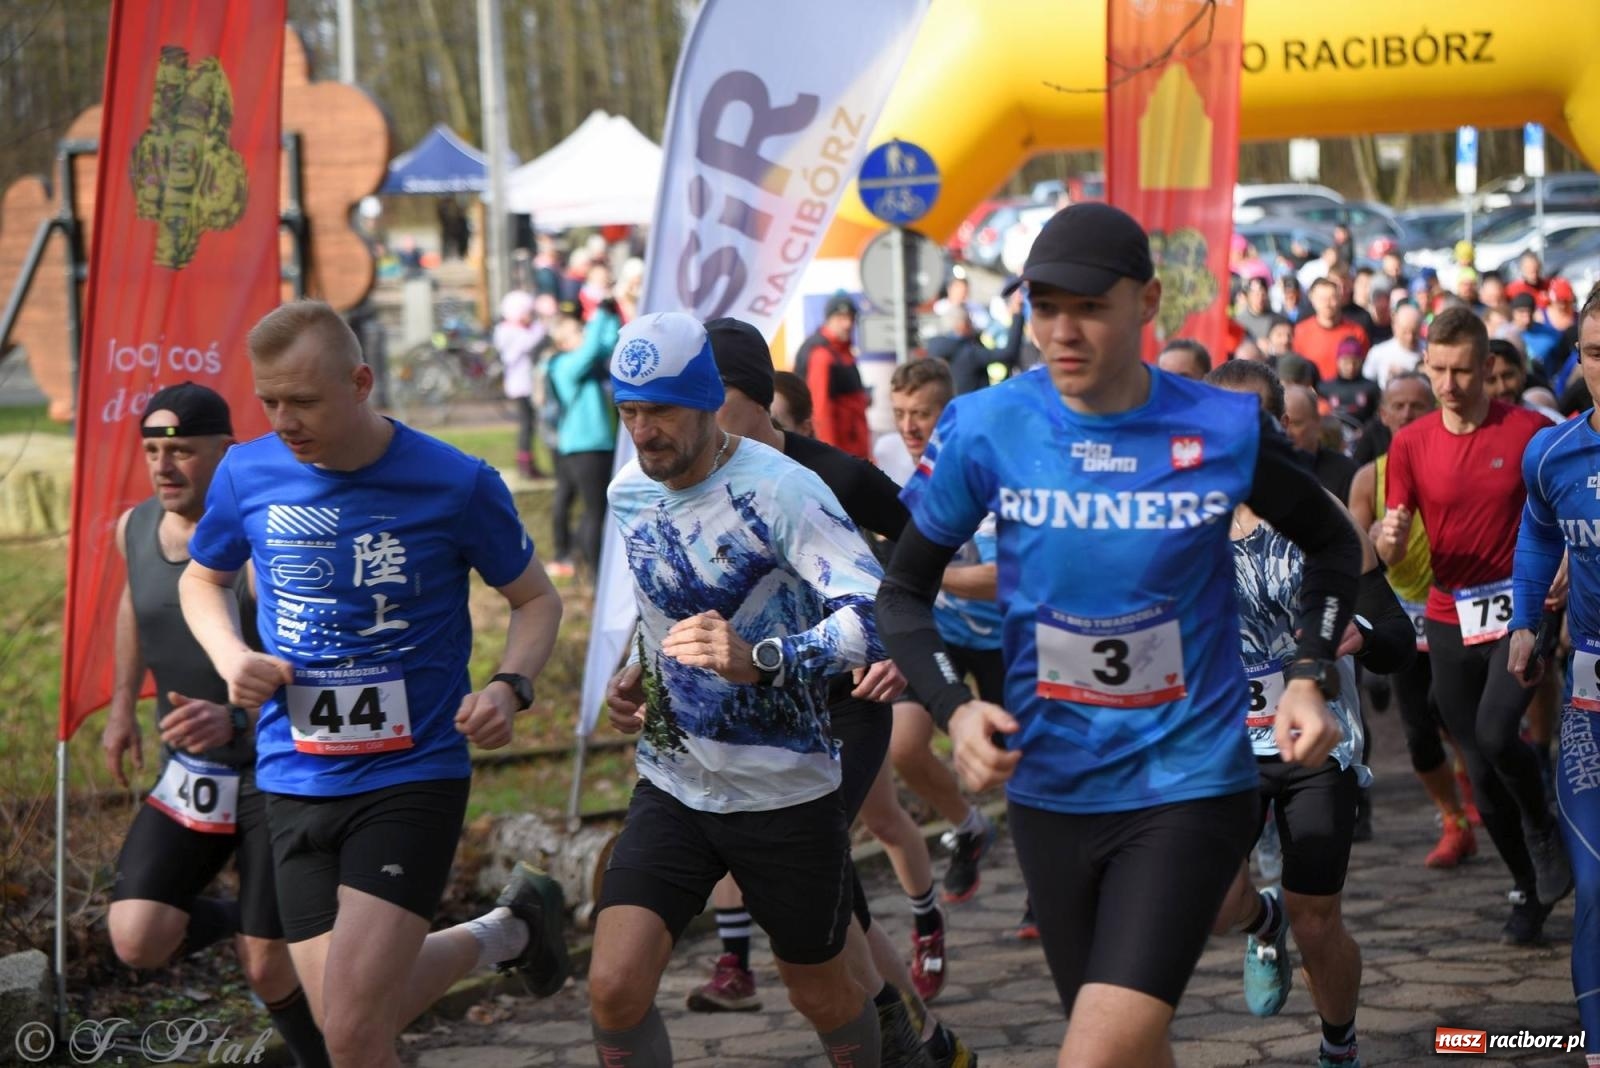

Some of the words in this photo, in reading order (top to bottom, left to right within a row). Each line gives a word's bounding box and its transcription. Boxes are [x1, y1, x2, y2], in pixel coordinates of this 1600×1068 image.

[1283, 25, 1496, 74] RACIBÓRZ
[747, 106, 866, 317] RACIBÓRZ
[168, 340, 222, 374] coś
[999, 486, 1230, 530] RUNNERS
[1472, 594, 1513, 628] 73
[1091, 638, 1132, 687] 3
[308, 686, 387, 734] 44
[177, 773, 219, 815] 40
